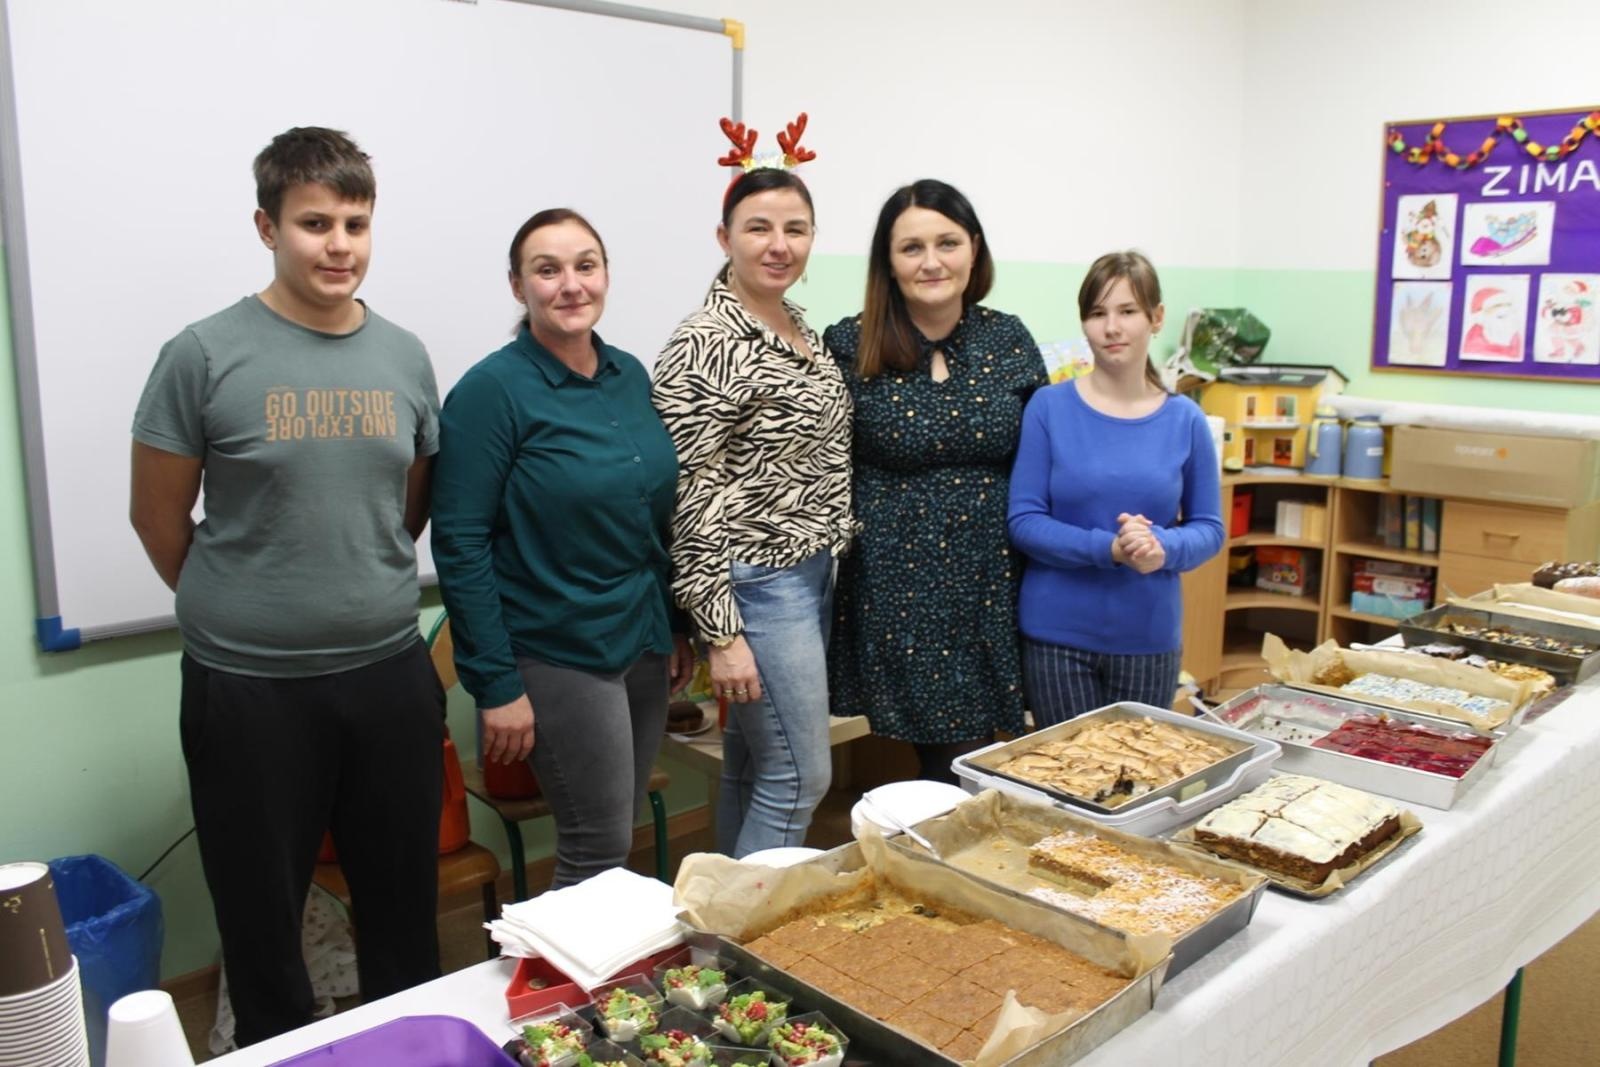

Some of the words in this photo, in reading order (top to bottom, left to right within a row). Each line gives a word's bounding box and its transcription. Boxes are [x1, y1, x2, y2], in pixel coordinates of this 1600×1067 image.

[1481, 160, 1600, 196] ZIMA
[265, 391, 297, 418] GO
[306, 389, 395, 416] OUTSIDE
[266, 415, 353, 441] EXPLORE
[362, 415, 396, 437] AND
